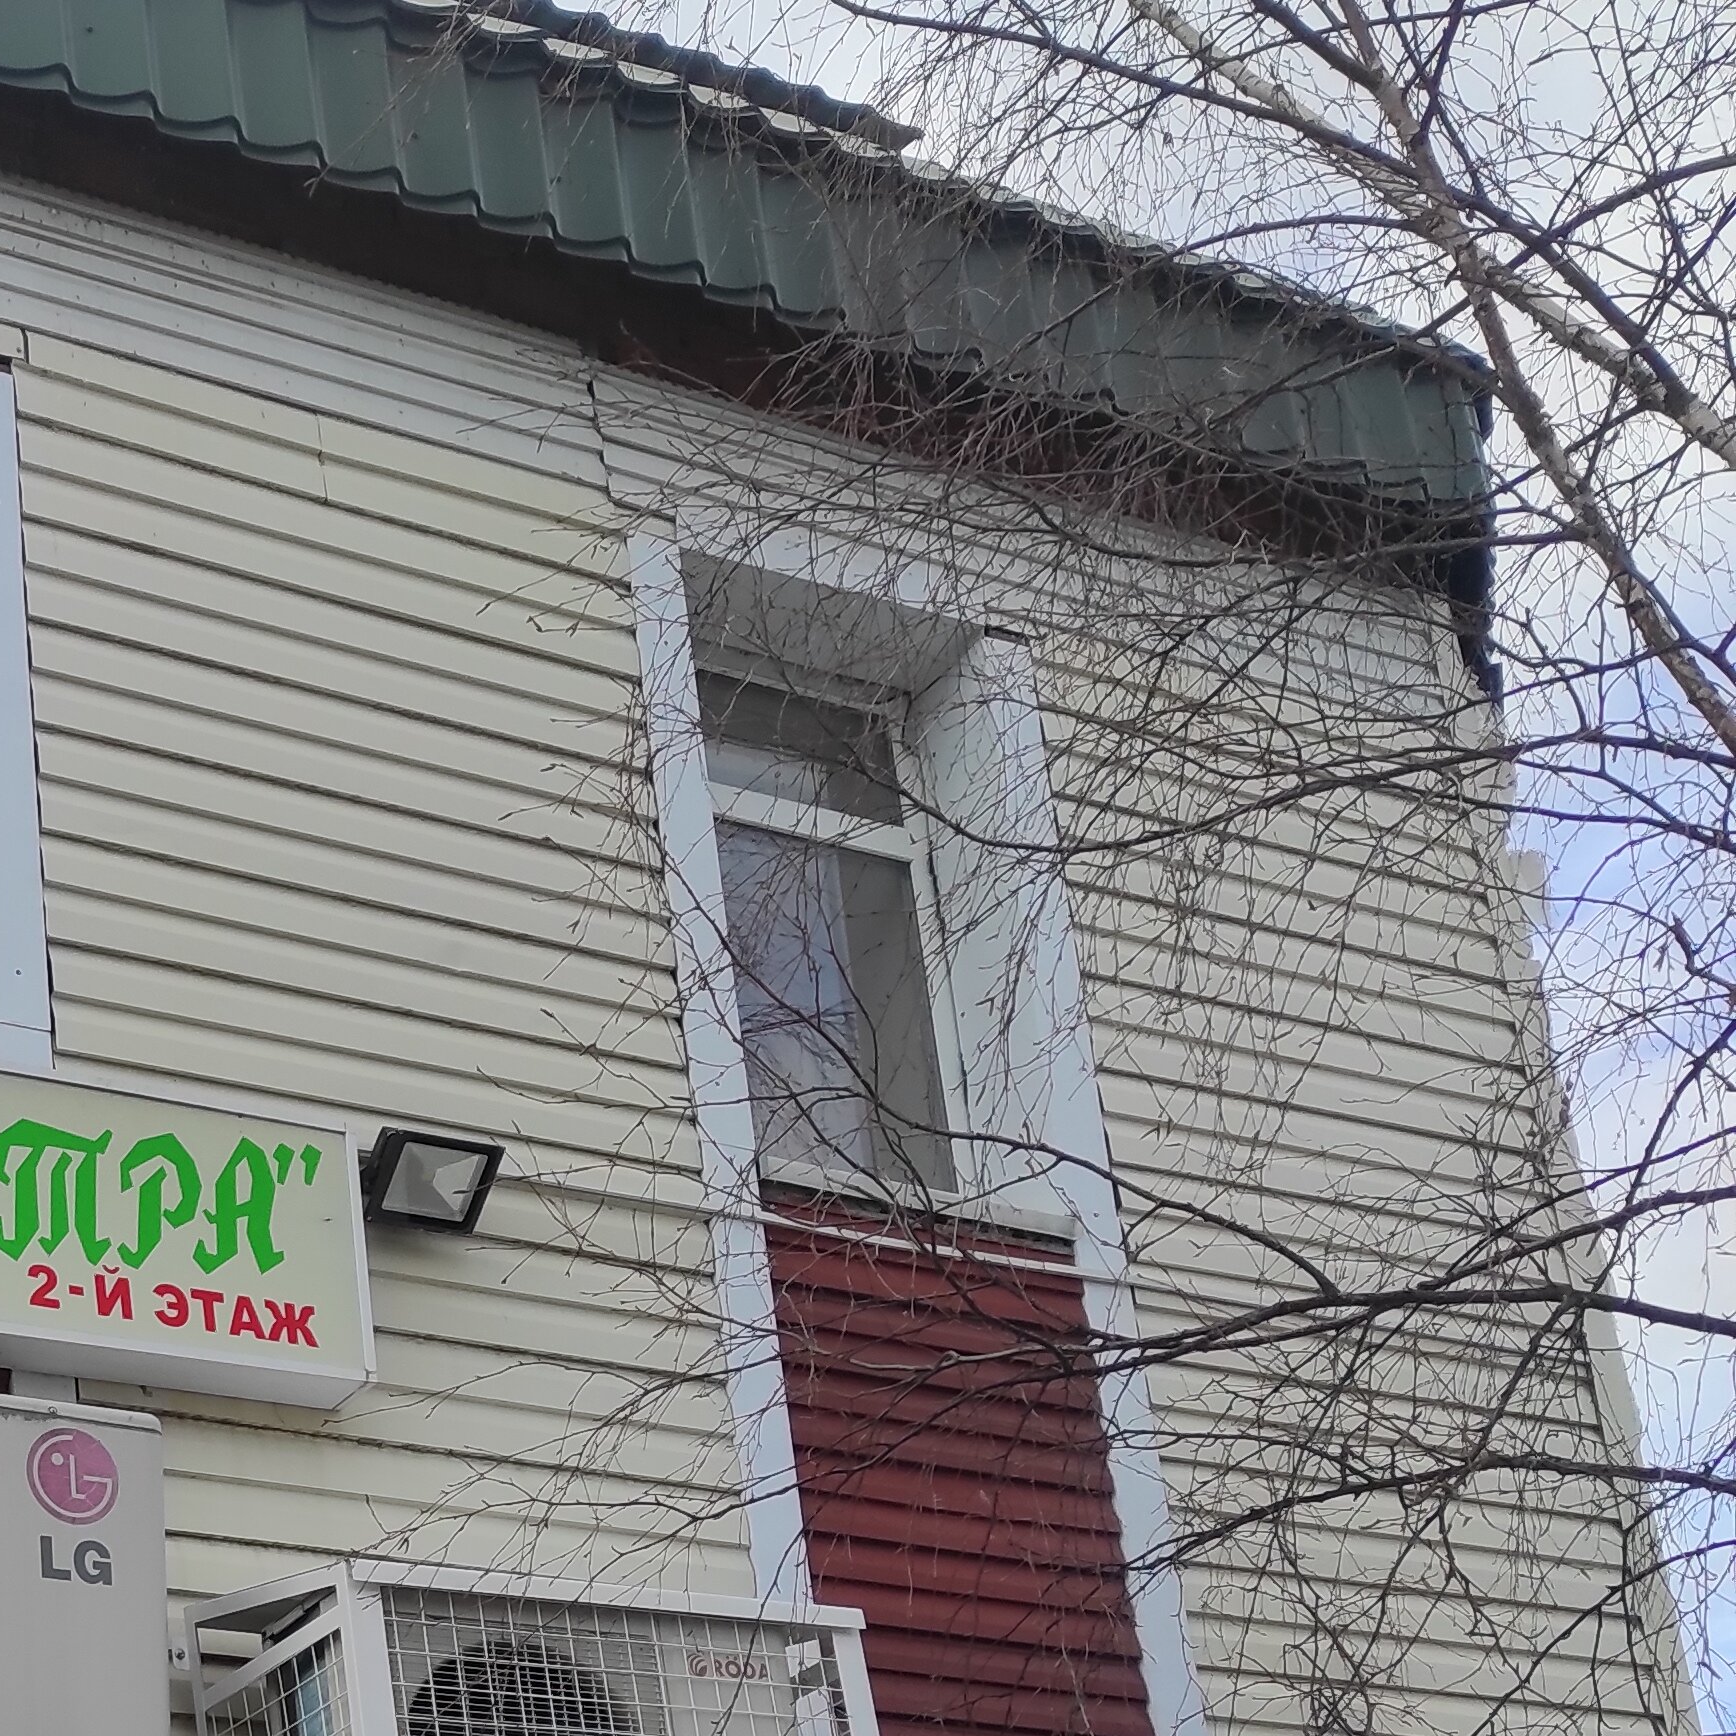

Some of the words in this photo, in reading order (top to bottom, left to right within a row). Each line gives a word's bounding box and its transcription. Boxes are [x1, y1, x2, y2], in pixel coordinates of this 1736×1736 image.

[28, 1263, 133, 1320] 2-Й
[154, 1283, 318, 1348] ЭТАЖ
[39, 1534, 113, 1586] LG
